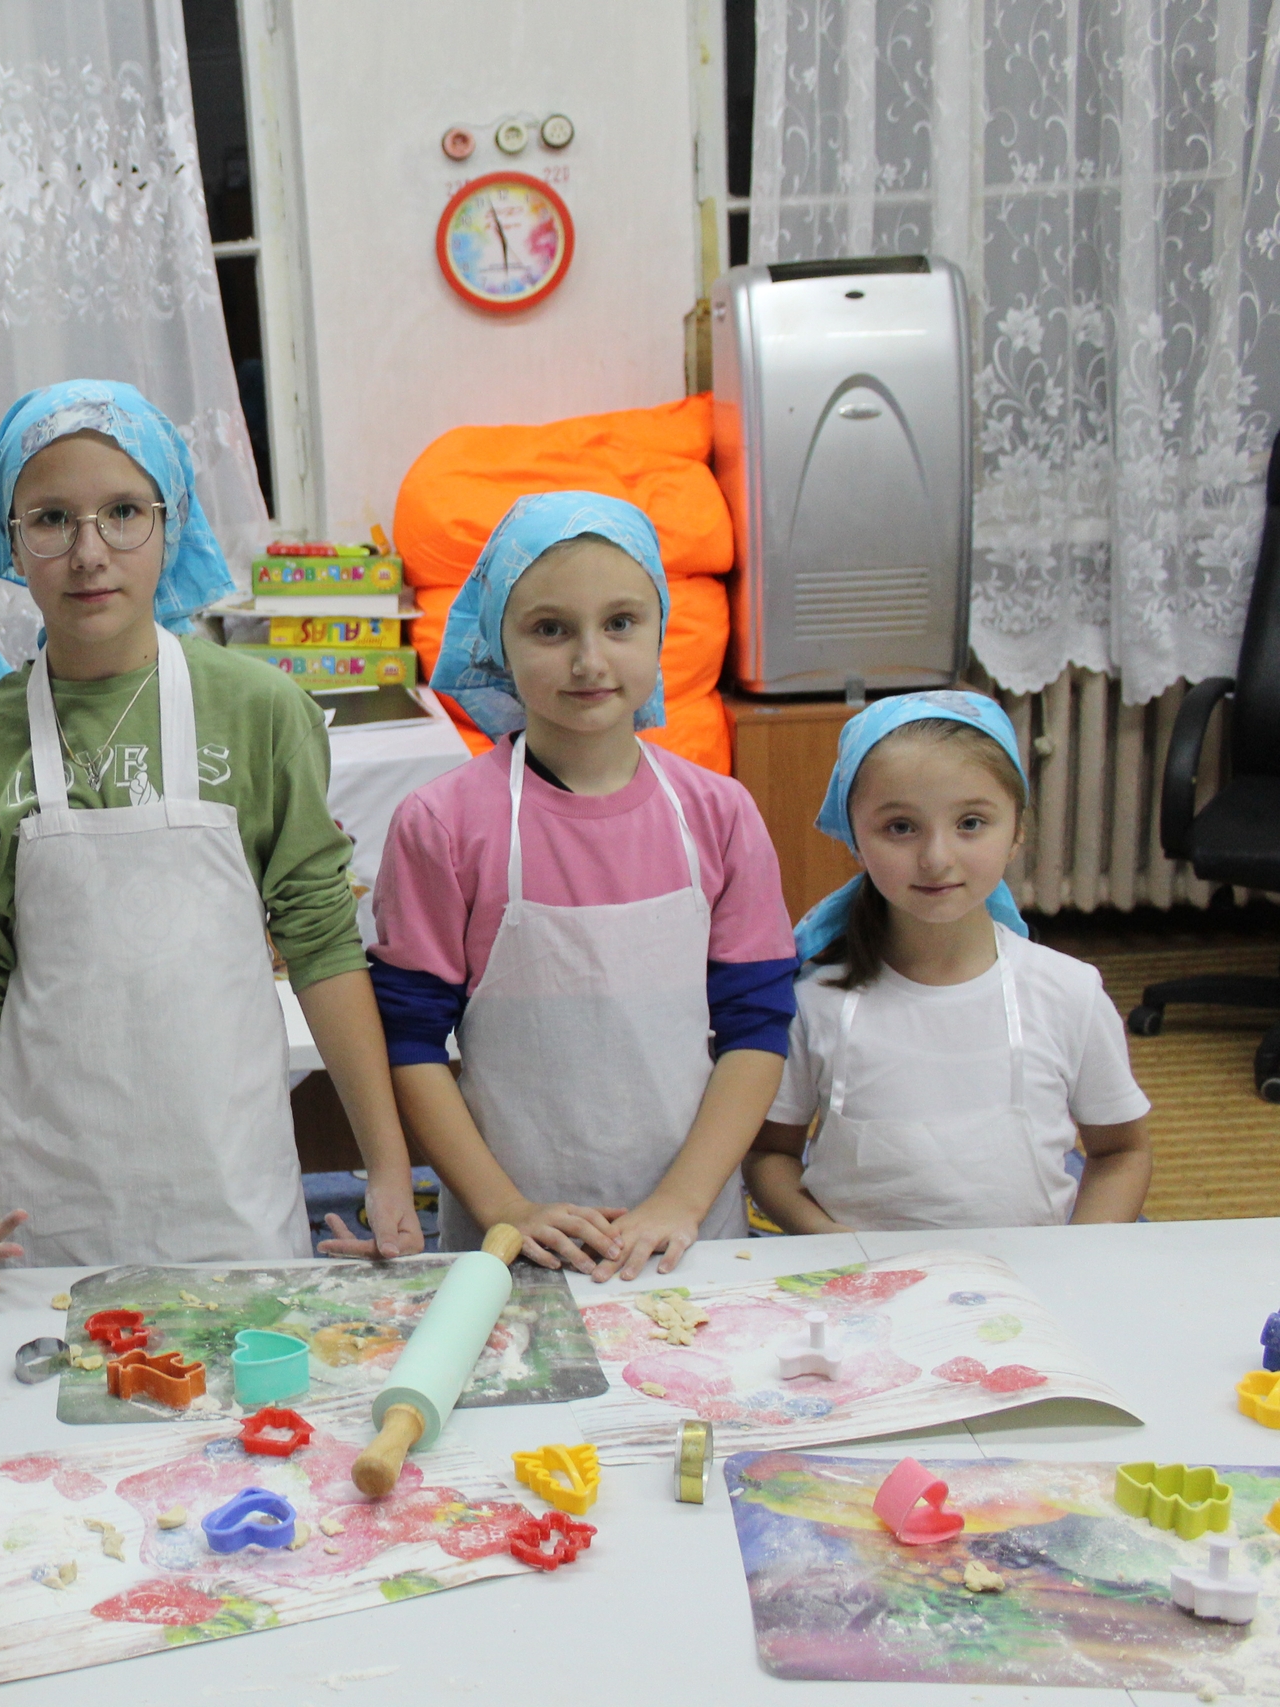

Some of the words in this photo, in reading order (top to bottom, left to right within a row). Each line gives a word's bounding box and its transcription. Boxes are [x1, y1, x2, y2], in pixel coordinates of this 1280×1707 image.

[301, 619, 360, 643] ALIAS
[265, 655, 366, 675] ОВИЧОК
[7, 743, 232, 807] LVES
